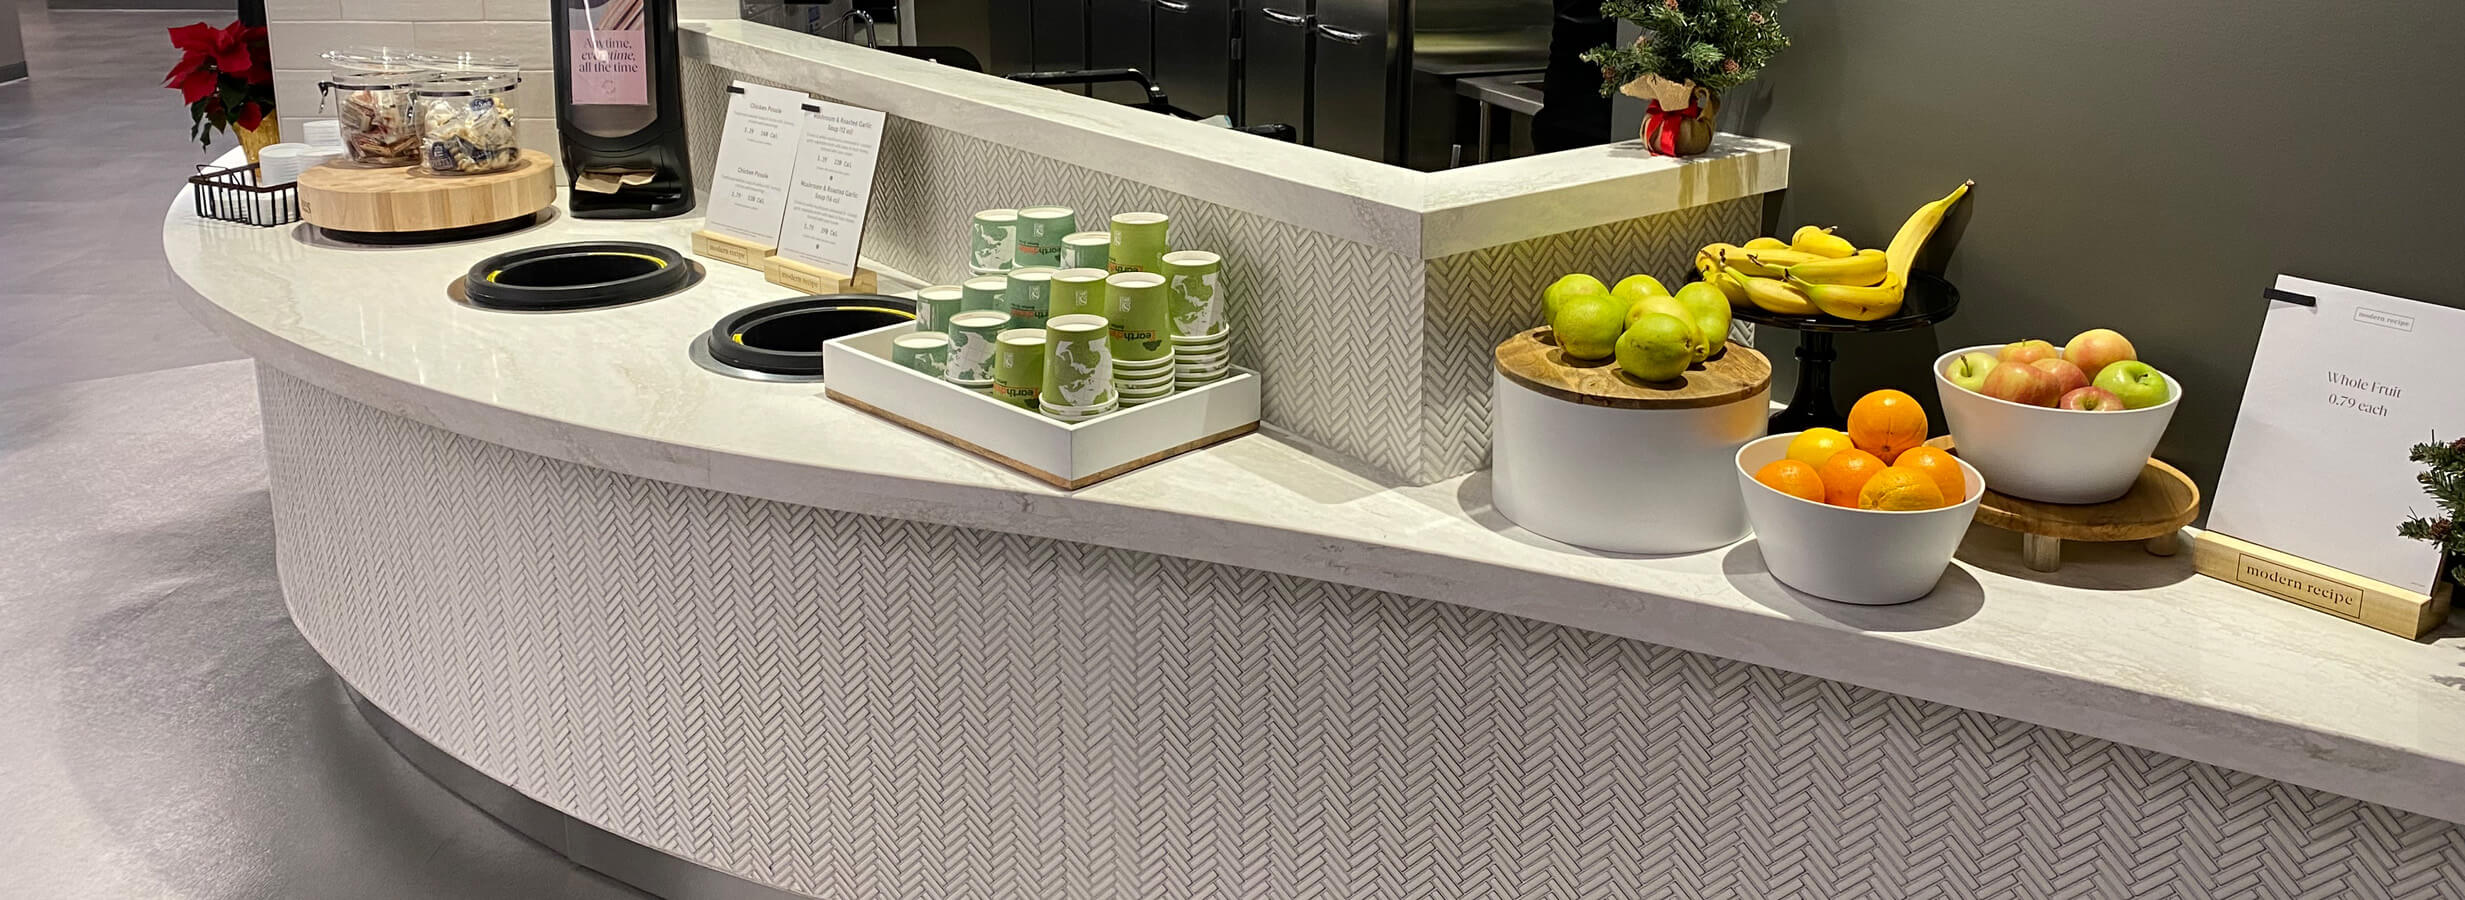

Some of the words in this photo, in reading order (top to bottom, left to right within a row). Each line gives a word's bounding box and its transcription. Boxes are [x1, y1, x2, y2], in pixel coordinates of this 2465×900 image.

[584, 38, 632, 50] Anytime,
[581, 50, 636, 62] evetime,
[579, 62, 591, 73] all
[594, 62, 612, 73] the
[613, 62, 638, 73] time
[2358, 311, 2385, 322] modern
[2386, 317, 2409, 327] recipe
[2328, 370, 2369, 391] Whole
[2371, 381, 2401, 398] Fruit
[2328, 393, 2356, 408] 0.79
[2358, 401, 2388, 417] each
[2246, 565, 2302, 590] modern
[2307, 584, 2353, 605] recipe
